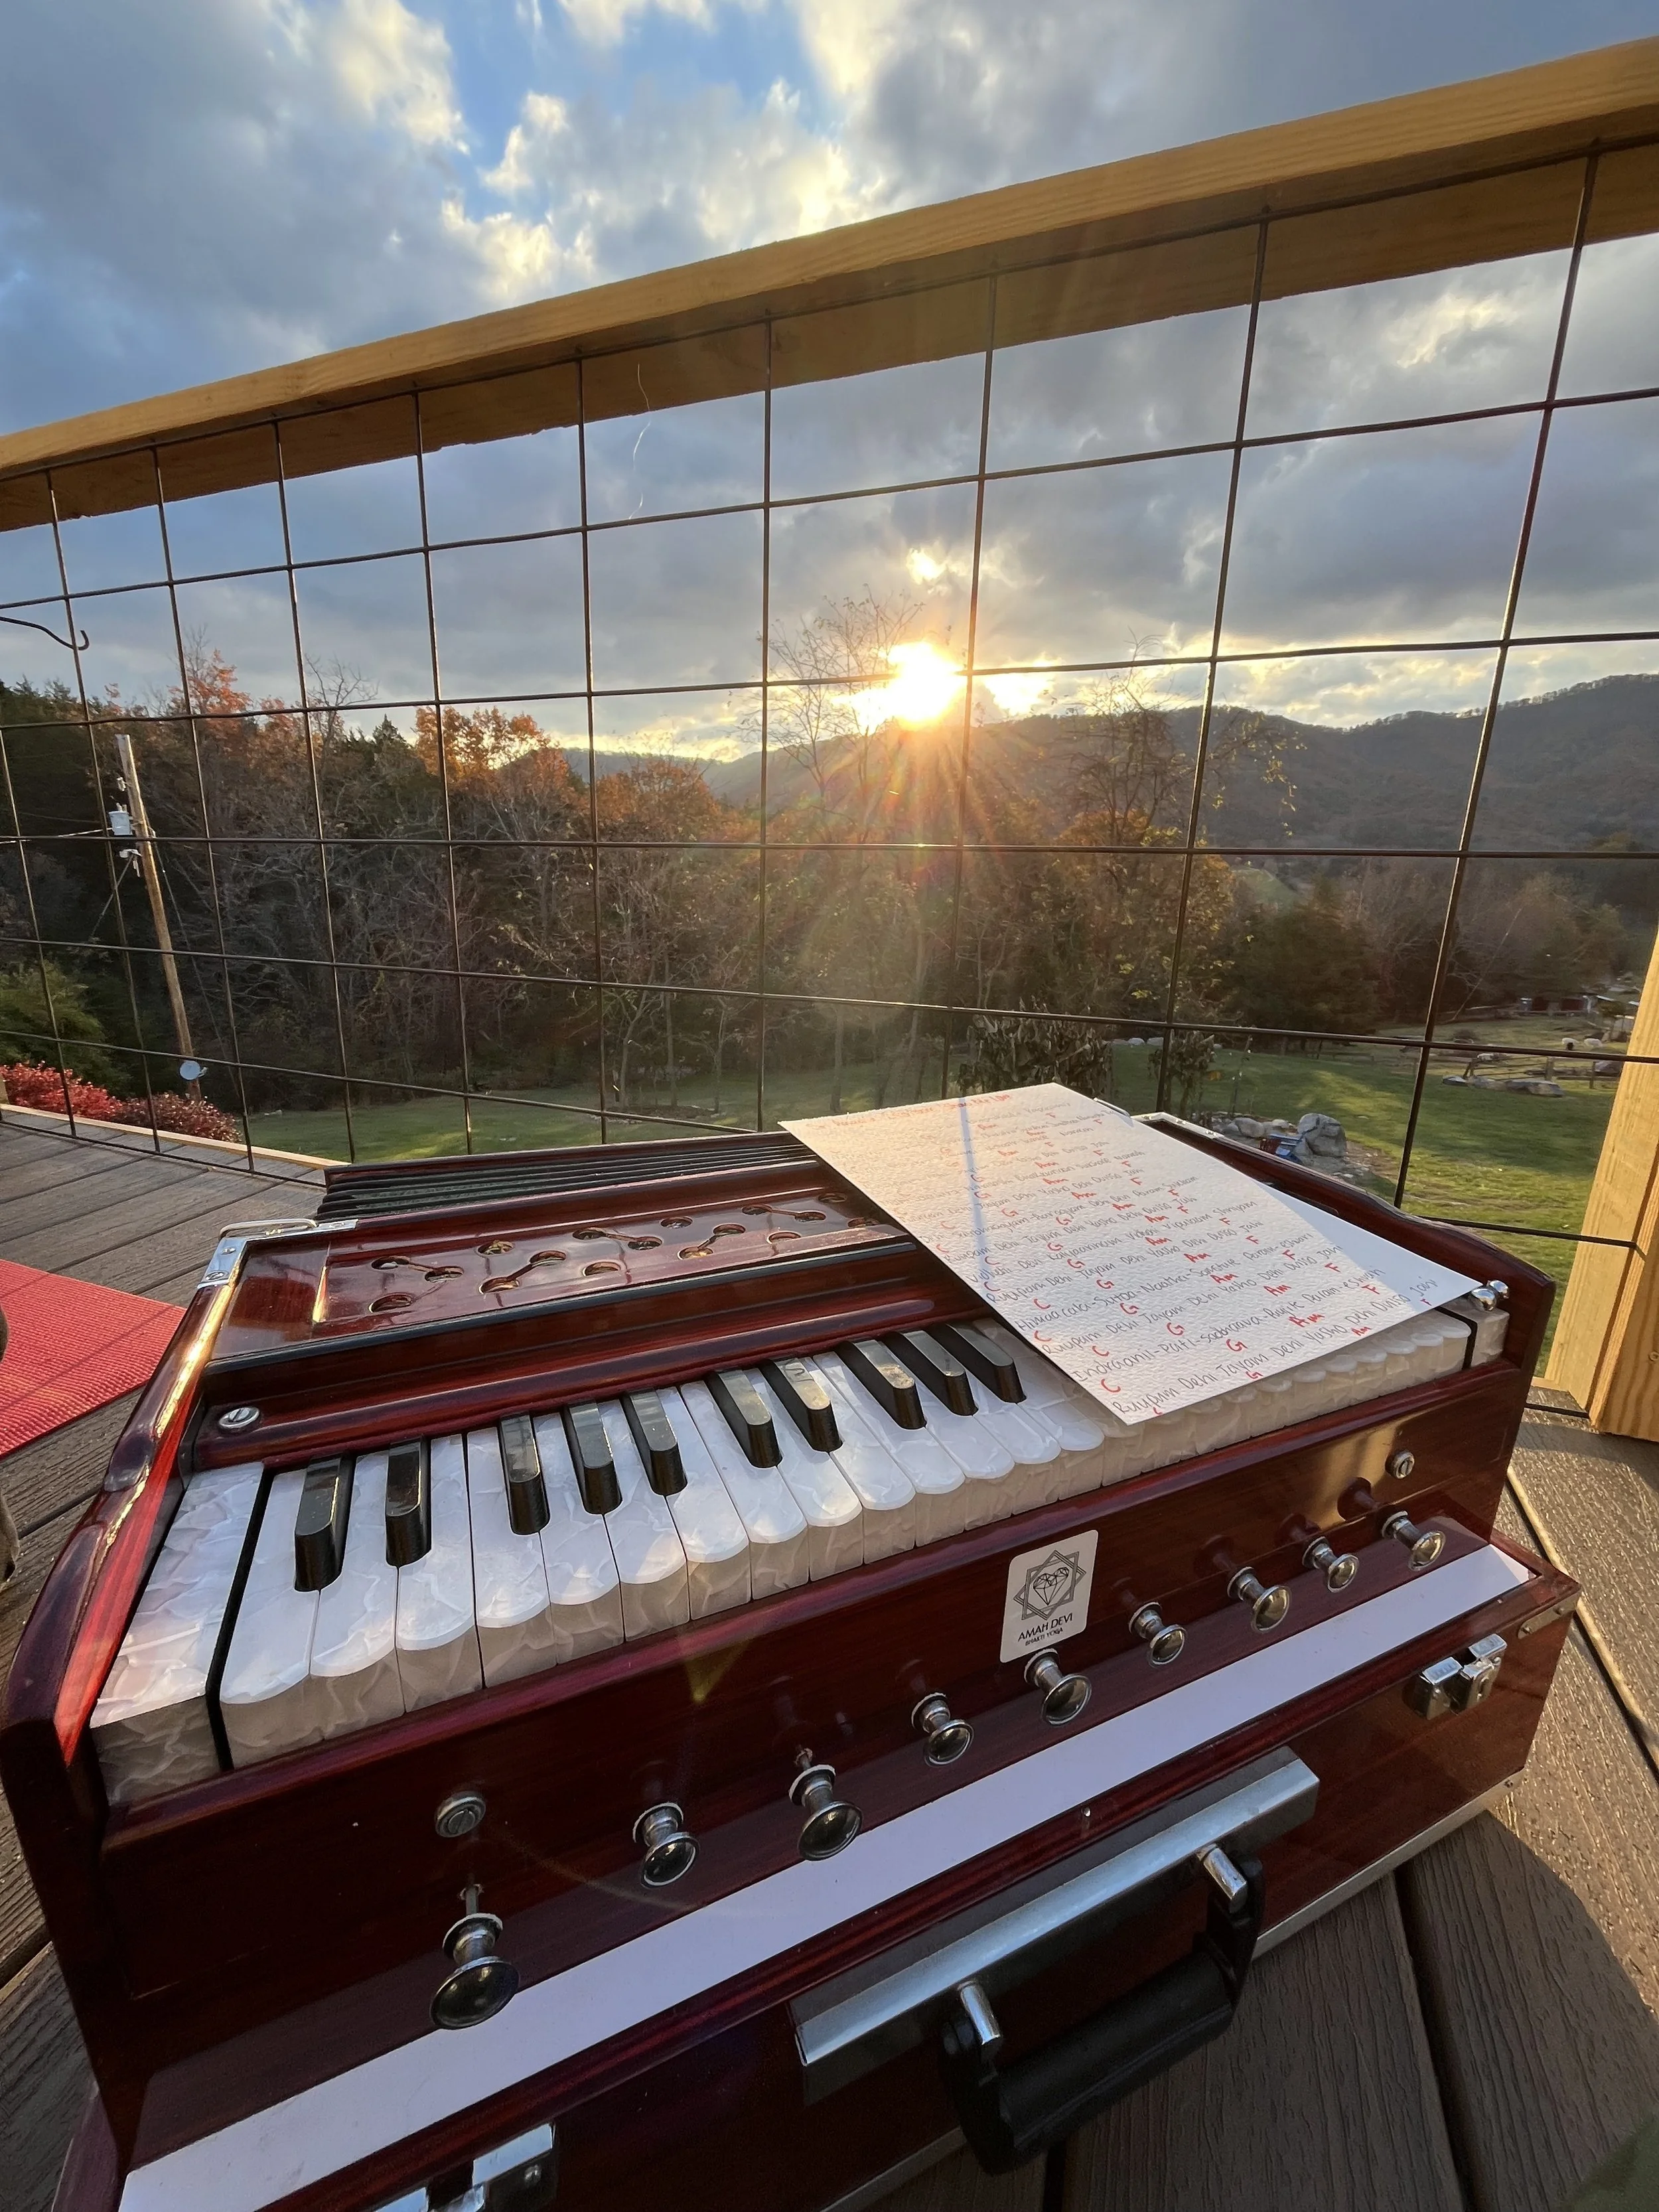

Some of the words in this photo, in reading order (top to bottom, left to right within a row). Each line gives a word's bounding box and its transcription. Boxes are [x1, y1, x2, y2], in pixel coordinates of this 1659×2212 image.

[999, 1207, 1019, 1218] G
[1072, 1191, 1096, 1201] Am
[1130, 1177, 1143, 1186] F
[1055, 1216, 1072, 1226] G
[1112, 1203, 1133, 1211] Am
[1167, 1188, 1179, 1199] F
[982, 1281, 1000, 1293] C
[1066, 1258, 1085, 1270] G
[1146, 1236, 1169, 1246] Am
[1220, 1216, 1232, 1226] F
[983, 1254, 999, 1267] C
[1045, 1242, 1062, 1253] G
[1145, 1214, 1168, 1224] Am
[1177, 1204, 1189, 1215] F
[1032, 1297, 1051, 1311] C
[1096, 1278, 1114, 1291] G
[1183, 1252, 1209, 1263] Am
[1244, 1235, 1260, 1245] F
[1032, 1329, 1052, 1343] C
[1119, 1301, 1139, 1316] G
[1210, 1274, 1236, 1285] Am
[1282, 1248, 1294, 1261] F
[1105, 1320, 1140, 1334] Dehi
[1186, 1293, 1220, 1307] Dehi
[1257, 1269, 1285, 1280] Dehi
[1090, 1344, 1110, 1359] C
[1165, 1321, 1185, 1337] G
[1264, 1285, 1290, 1295] Am
[1324, 1262, 1338, 1272] F
[1100, 1377, 1121, 1394] C
[1225, 1339, 1248, 1353] G
[1288, 1313, 1323, 1327] Am
[1362, 1284, 1380, 1295] F
[1177, 1373, 1219, 1390] Dehi
[1269, 1339, 1305, 1357] Dehi
[1344, 1310, 1378, 1325] Dehi
[1017, 1622, 1048, 1643] AMAH
[1050, 1613, 1073, 1629] DEVI
[1025, 1635, 1045, 1647] BHAKTI
[1046, 1627, 1064, 1637] YOGA
